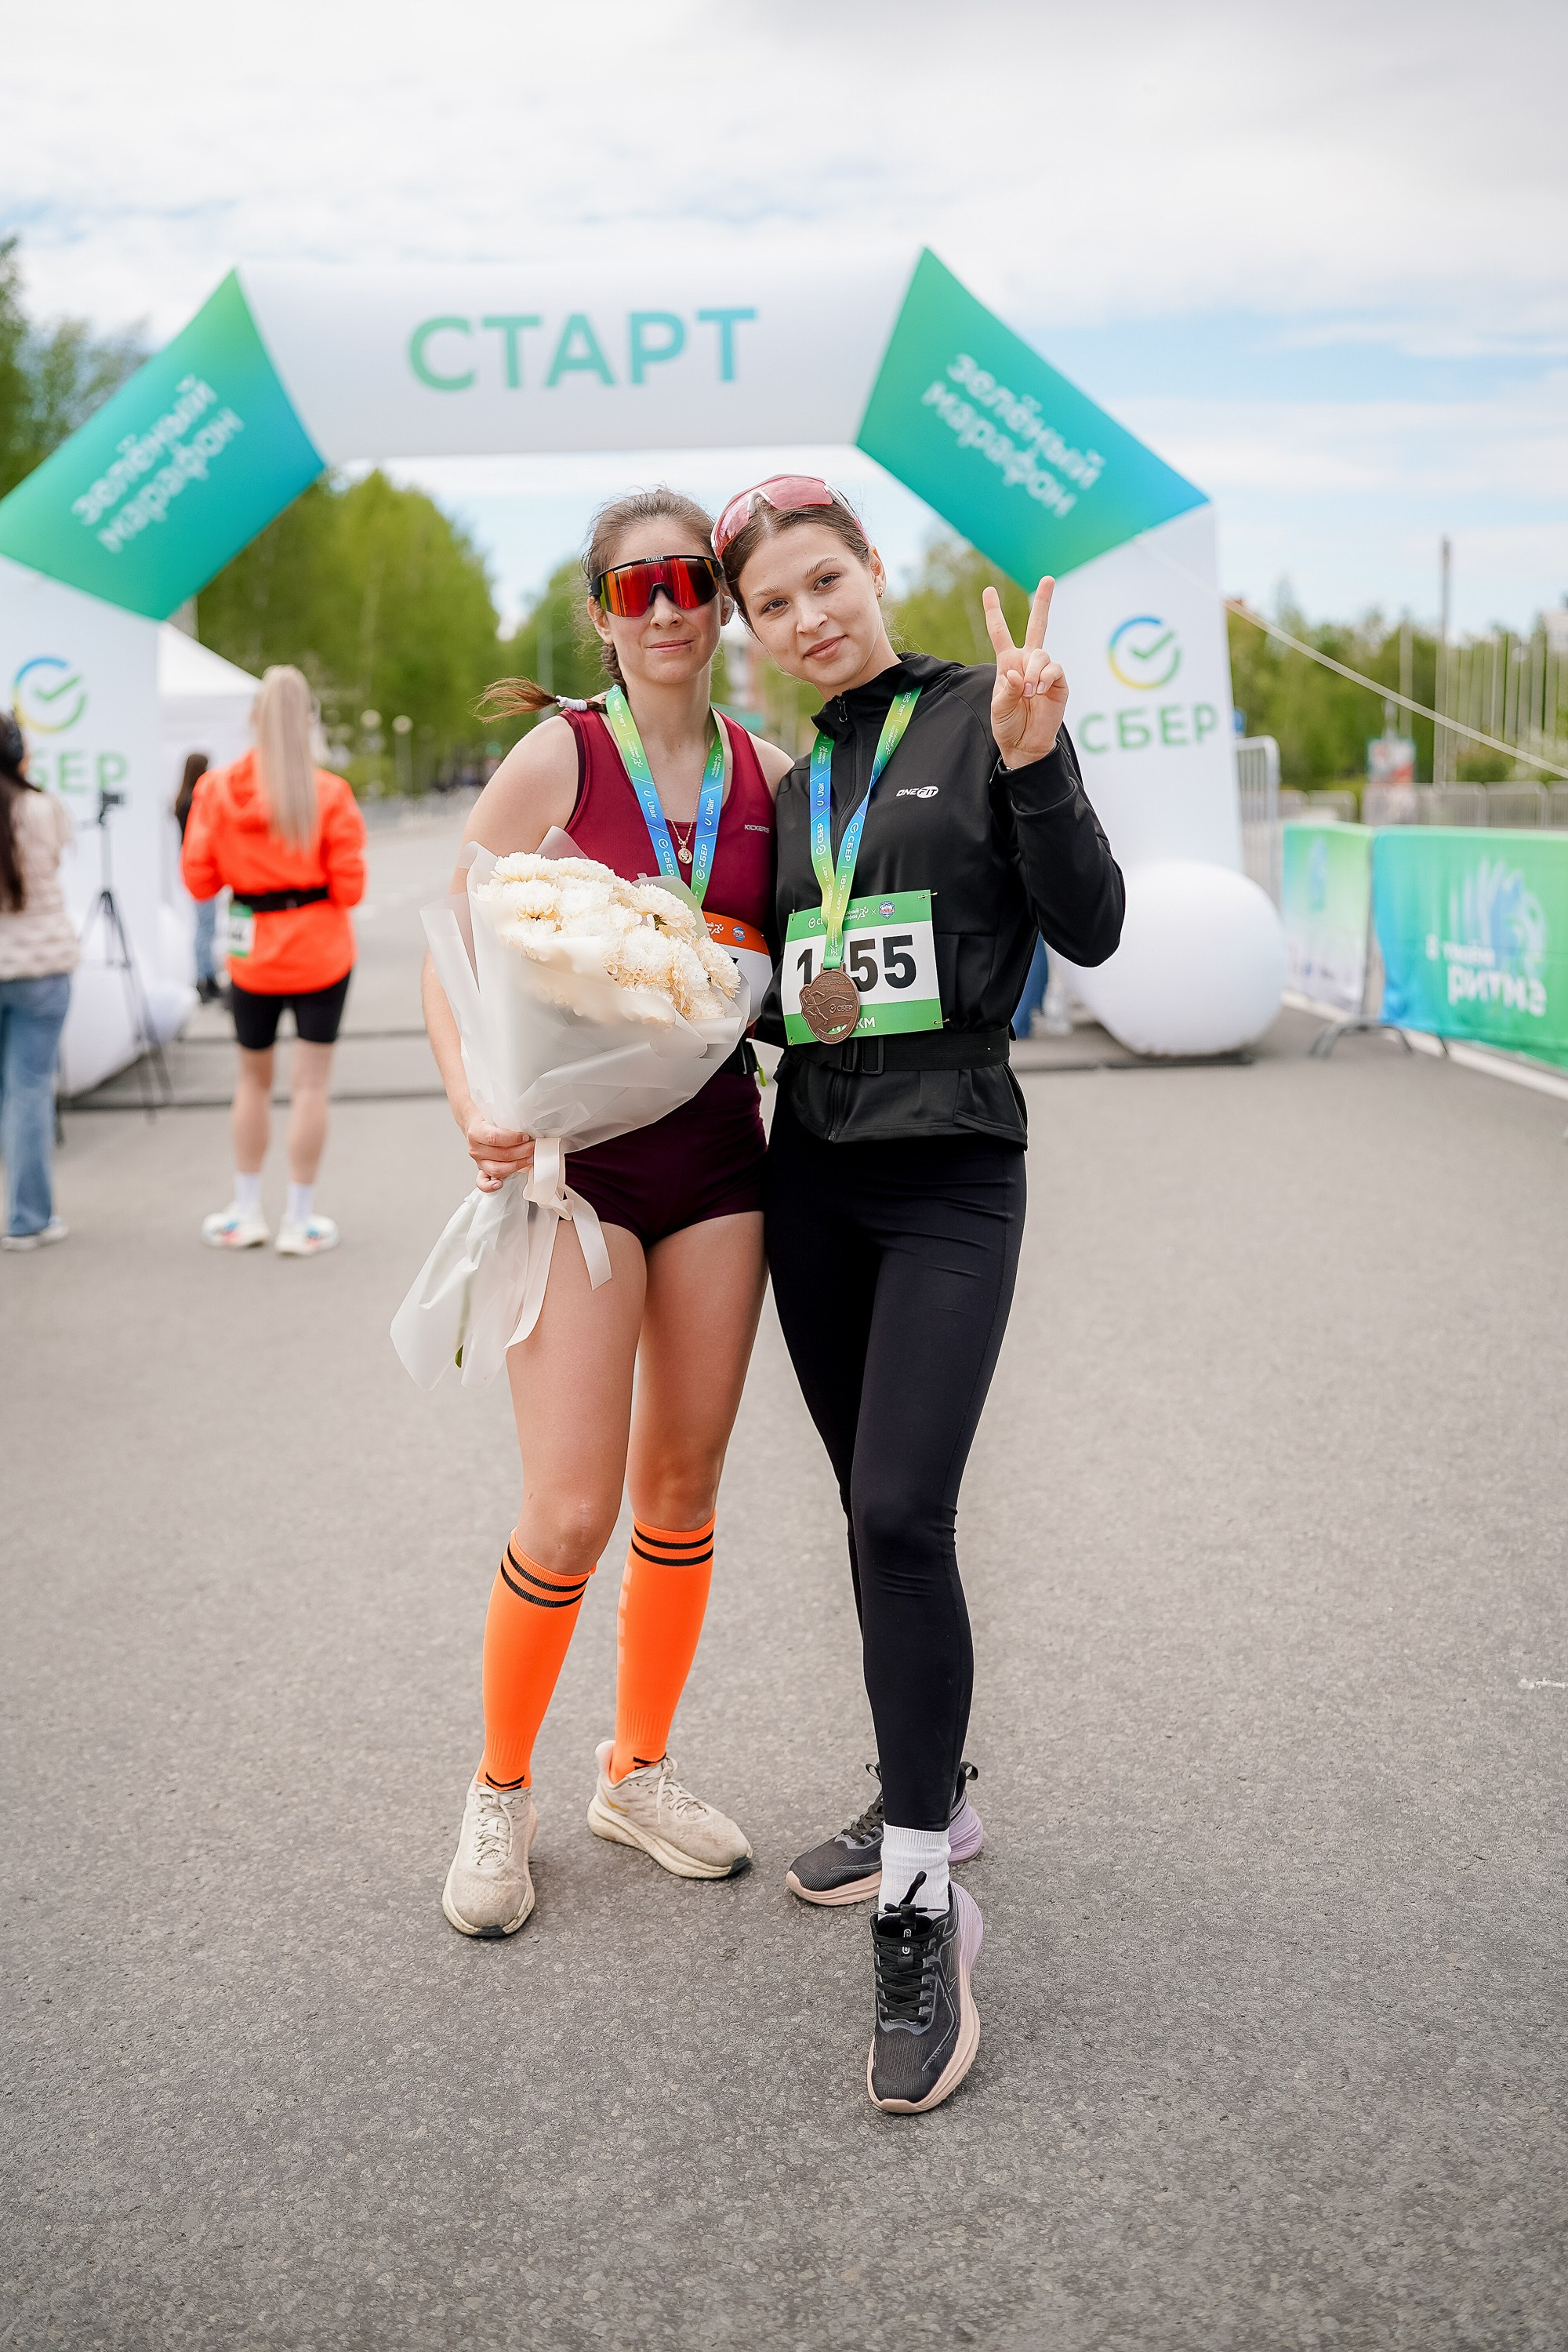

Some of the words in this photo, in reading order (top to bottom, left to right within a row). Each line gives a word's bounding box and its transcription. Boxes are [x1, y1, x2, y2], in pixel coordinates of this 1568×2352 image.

[409, 306, 759, 391] СТАРТ
[922, 381, 1077, 518] марафон
[98, 407, 244, 554] марафон
[903, 691, 912, 703] 185
[1078, 702, 1218, 754] СБЕР
[30, 750, 129, 793] БЕР
[647, 801, 657, 818] Utair
[706, 798, 715, 815] Utair
[662, 851, 674, 876] СБЕР
[699, 844, 708, 868] СБЕР
[845, 836, 855, 862] СБЕР
[797, 935, 916, 992] 155
